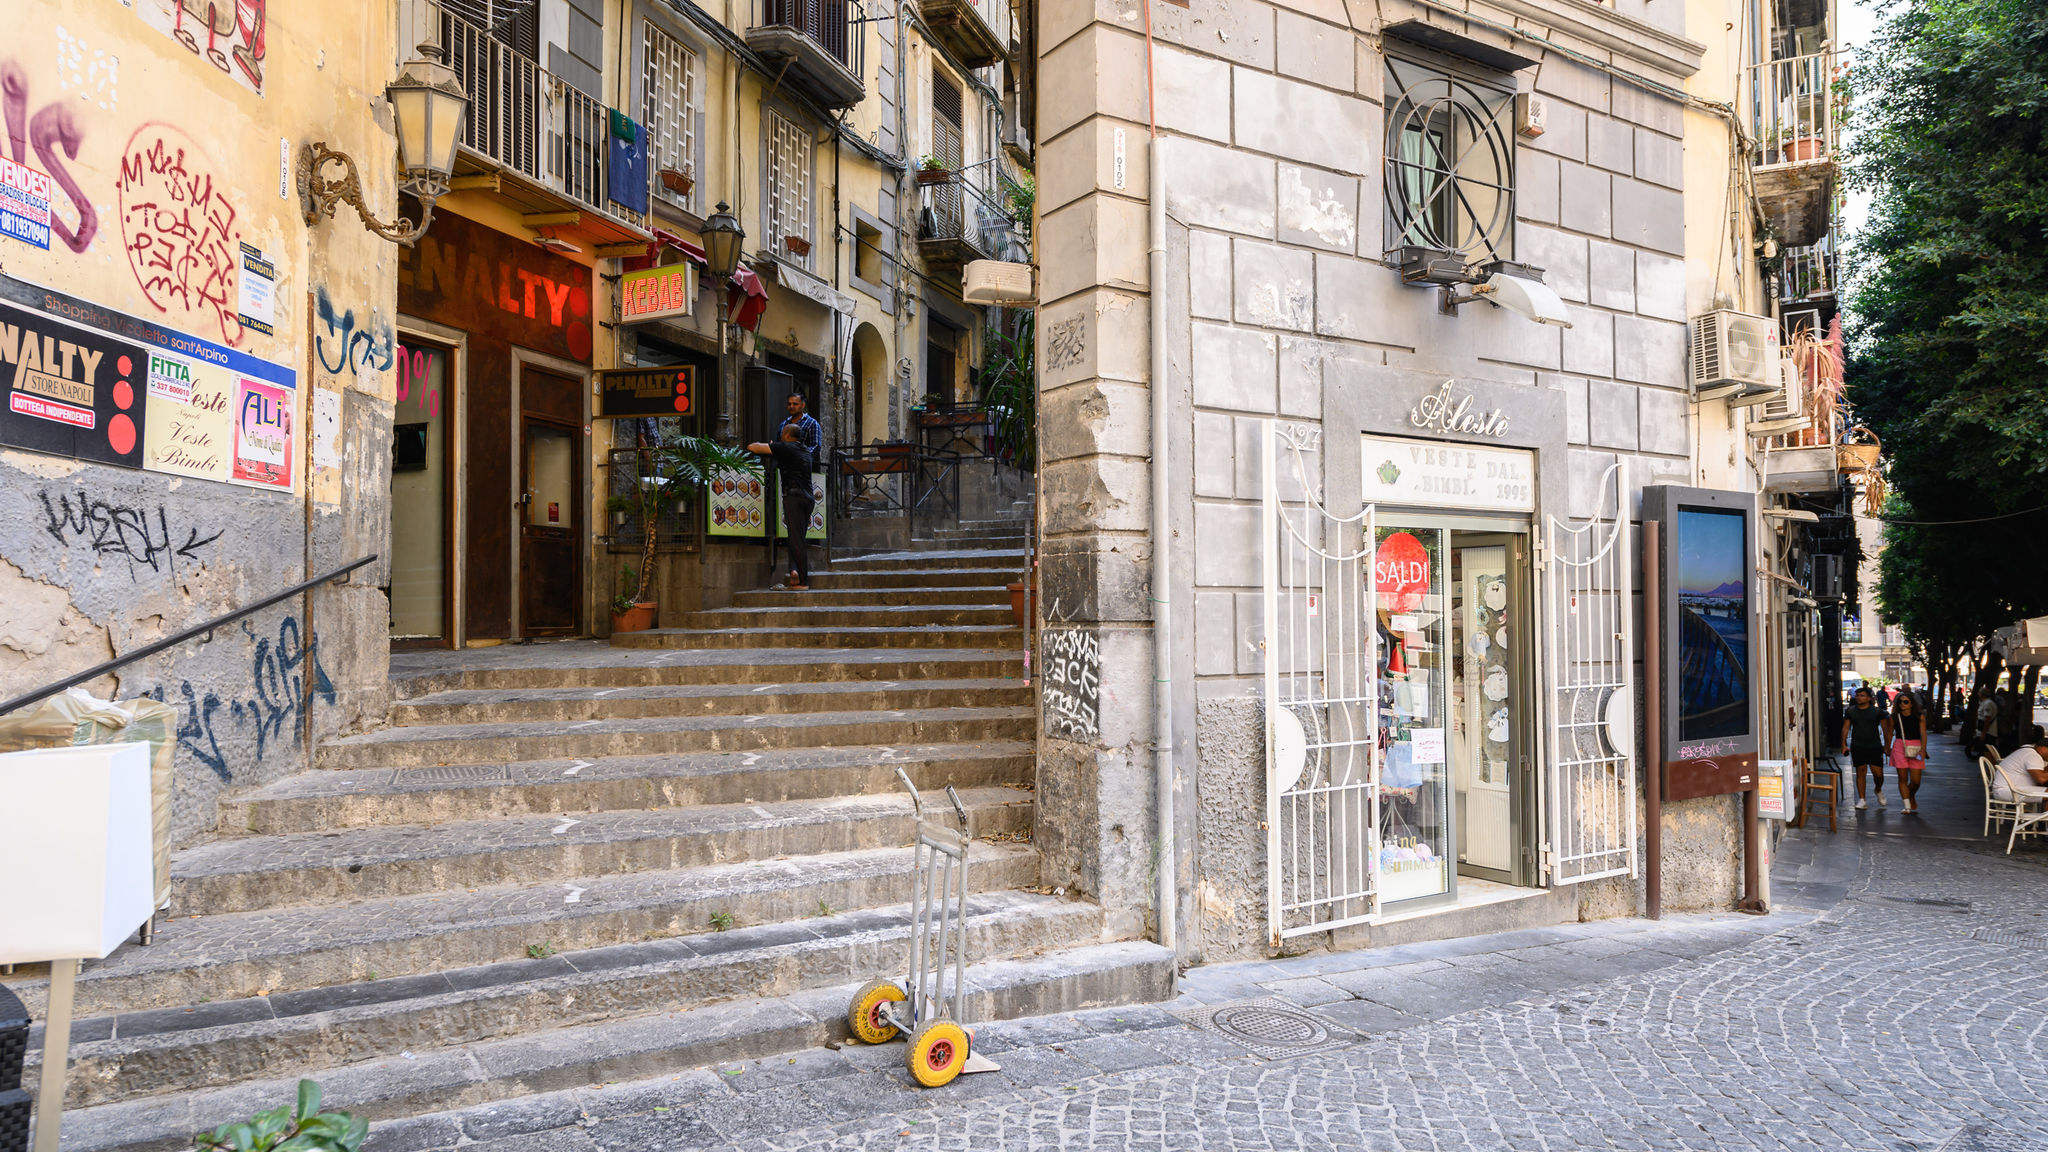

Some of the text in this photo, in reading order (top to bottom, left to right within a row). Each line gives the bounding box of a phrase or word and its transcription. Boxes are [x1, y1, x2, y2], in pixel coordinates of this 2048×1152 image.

[1, 210, 49, 246] 08119370940
[244, 256, 273, 279] VENDITA
[623, 272, 684, 317] KEBAB
[44, 294, 112, 330] Shopping
[114, 318, 168, 346] Vicoletto
[171, 336, 229, 364] sant'Arpino
[151, 355, 190, 383] FITTA
[31, 375, 91, 404] STORE NAPOLI
[156, 381, 168, 392] 337
[605, 373, 676, 399] PENALTY
[14, 397, 92, 425] BOTTEGA INDIPENDENTE
[169, 421, 213, 448] Veste
[156, 444, 219, 473] Bimbi
[1410, 447, 1477, 470] VESTE
[1496, 484, 1528, 502] 1995
[1375, 561, 1428, 584] SALDI
